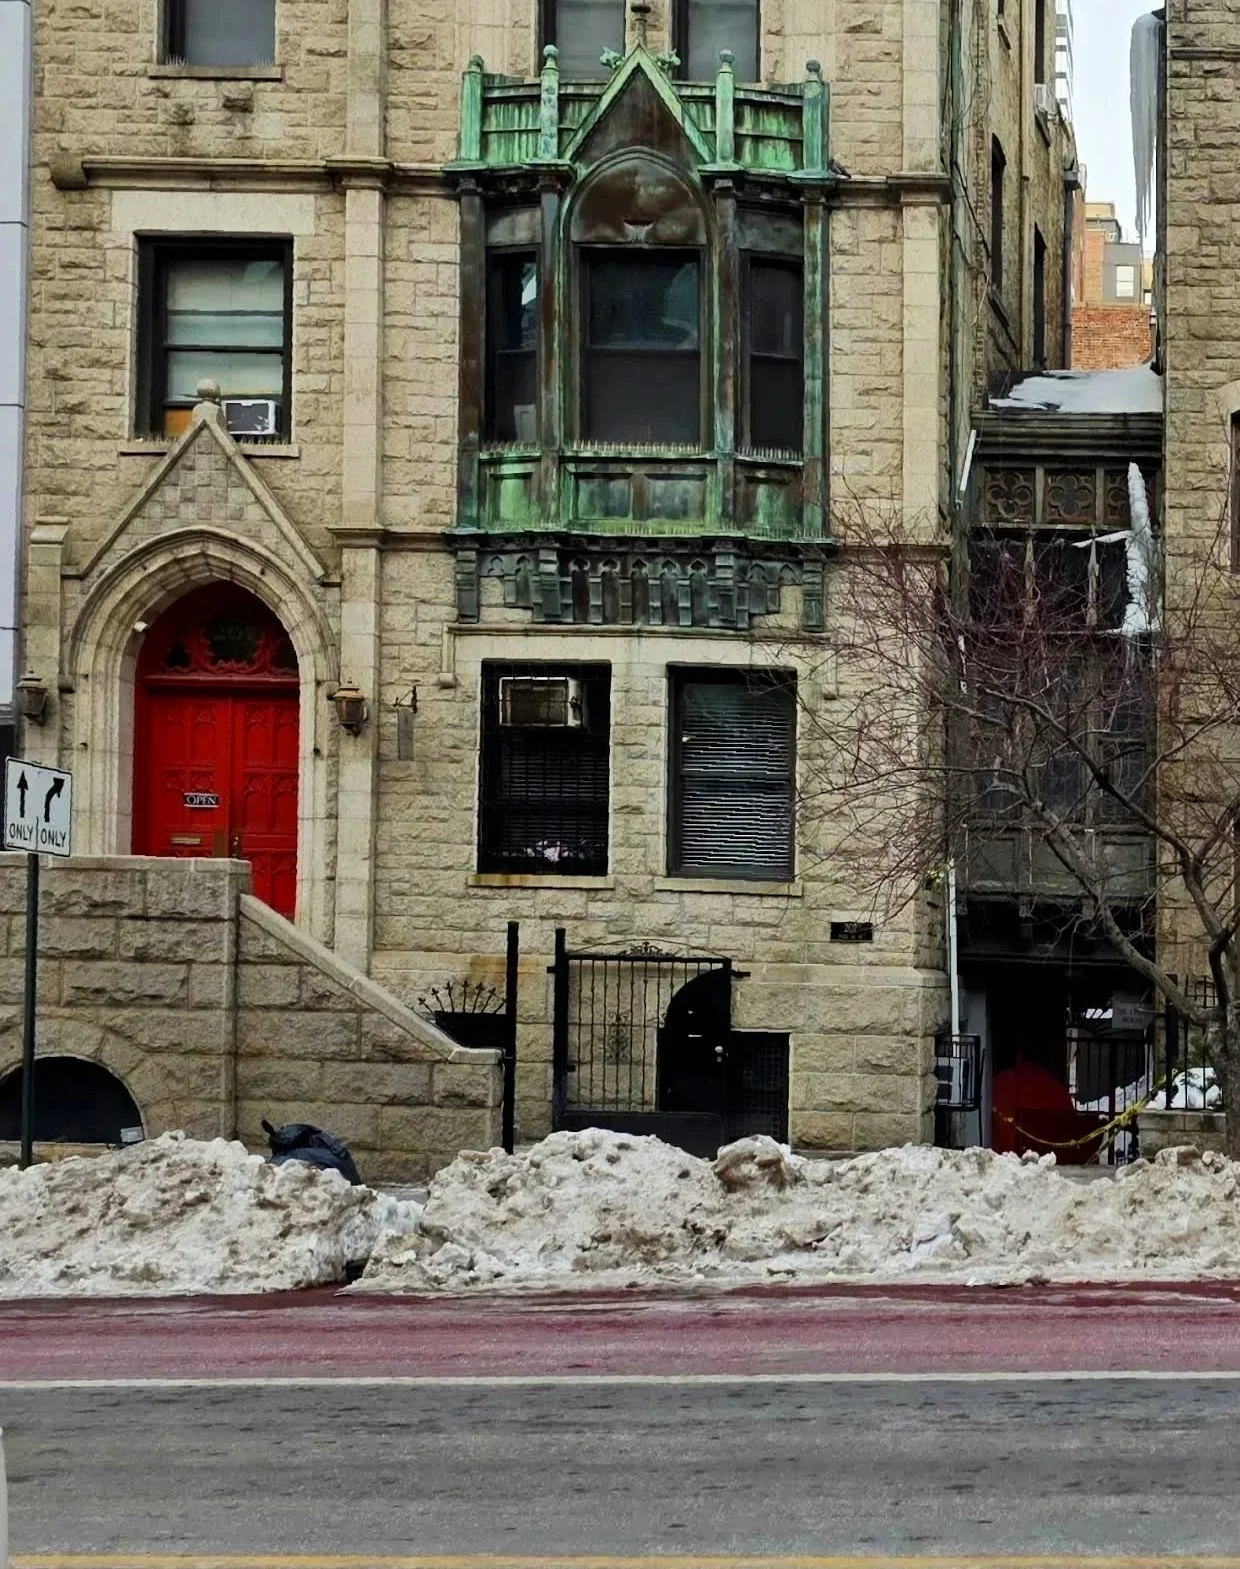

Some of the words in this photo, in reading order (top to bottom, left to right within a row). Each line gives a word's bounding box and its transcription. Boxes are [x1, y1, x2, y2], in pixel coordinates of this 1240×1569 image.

[186, 795, 217, 805] OPEN
[9, 823, 34, 842] ONLY
[40, 828, 67, 848] ONLY
